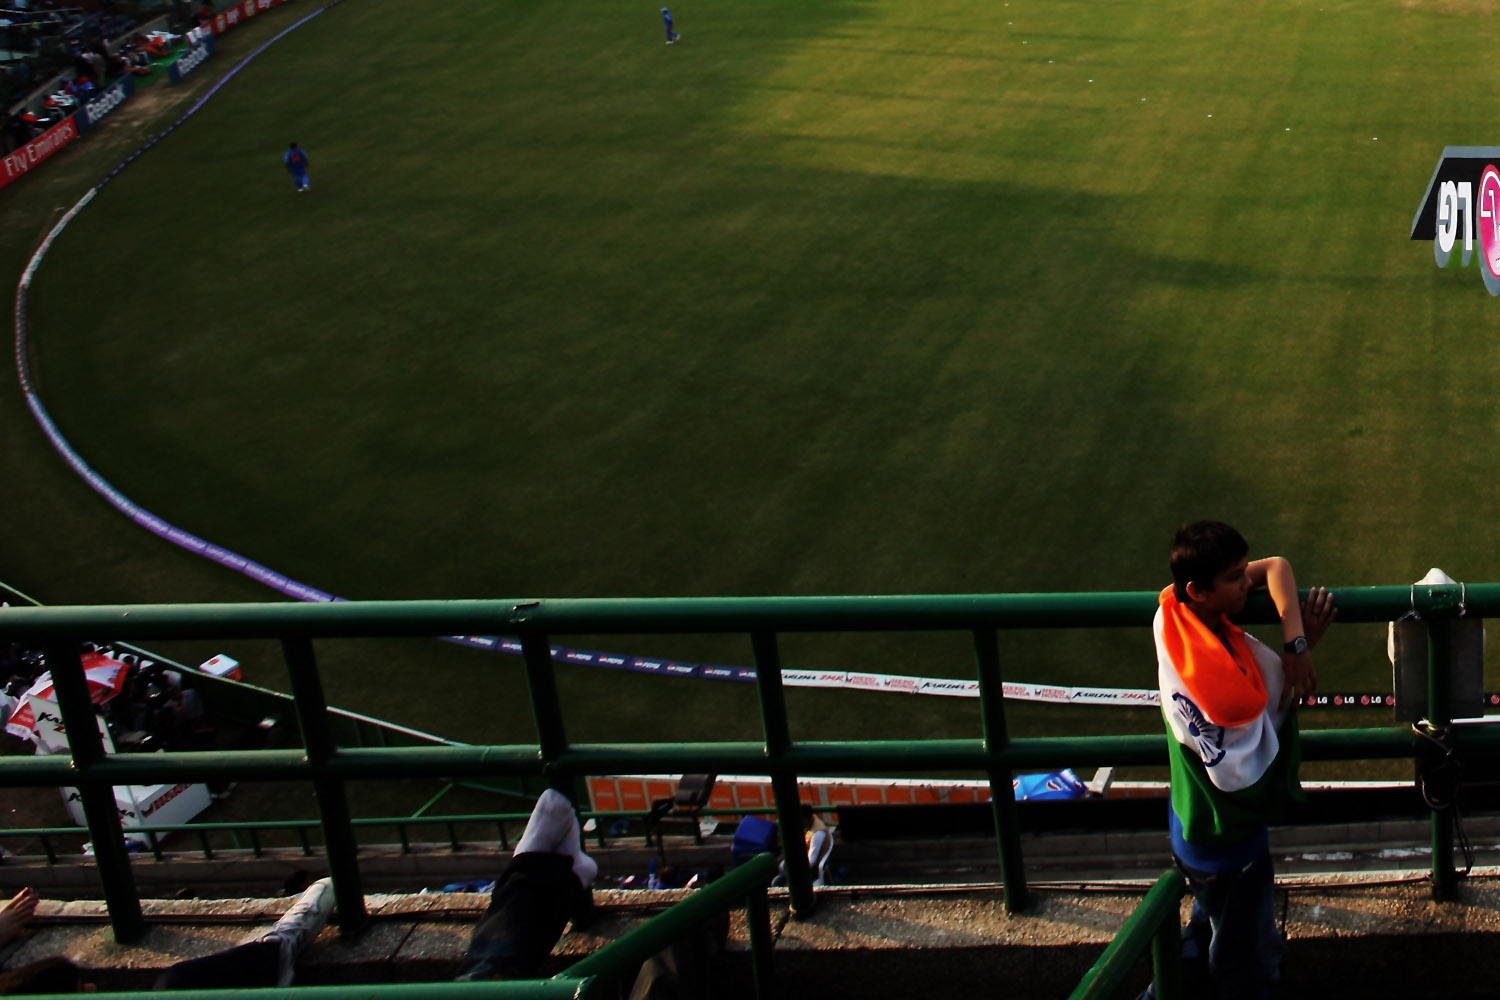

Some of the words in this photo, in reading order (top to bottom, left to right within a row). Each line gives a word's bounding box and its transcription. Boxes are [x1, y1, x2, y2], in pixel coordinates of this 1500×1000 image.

[177, 42, 210, 78] Reebok
[85, 82, 126, 125] Reebok
[5, 151, 28, 177] Fly
[26, 123, 73, 167] Emirates
[1437, 180, 1473, 253] LG
[1317, 696, 1328, 704] LG
[1344, 696, 1355, 704] LG
[1371, 696, 1382, 704] LG
